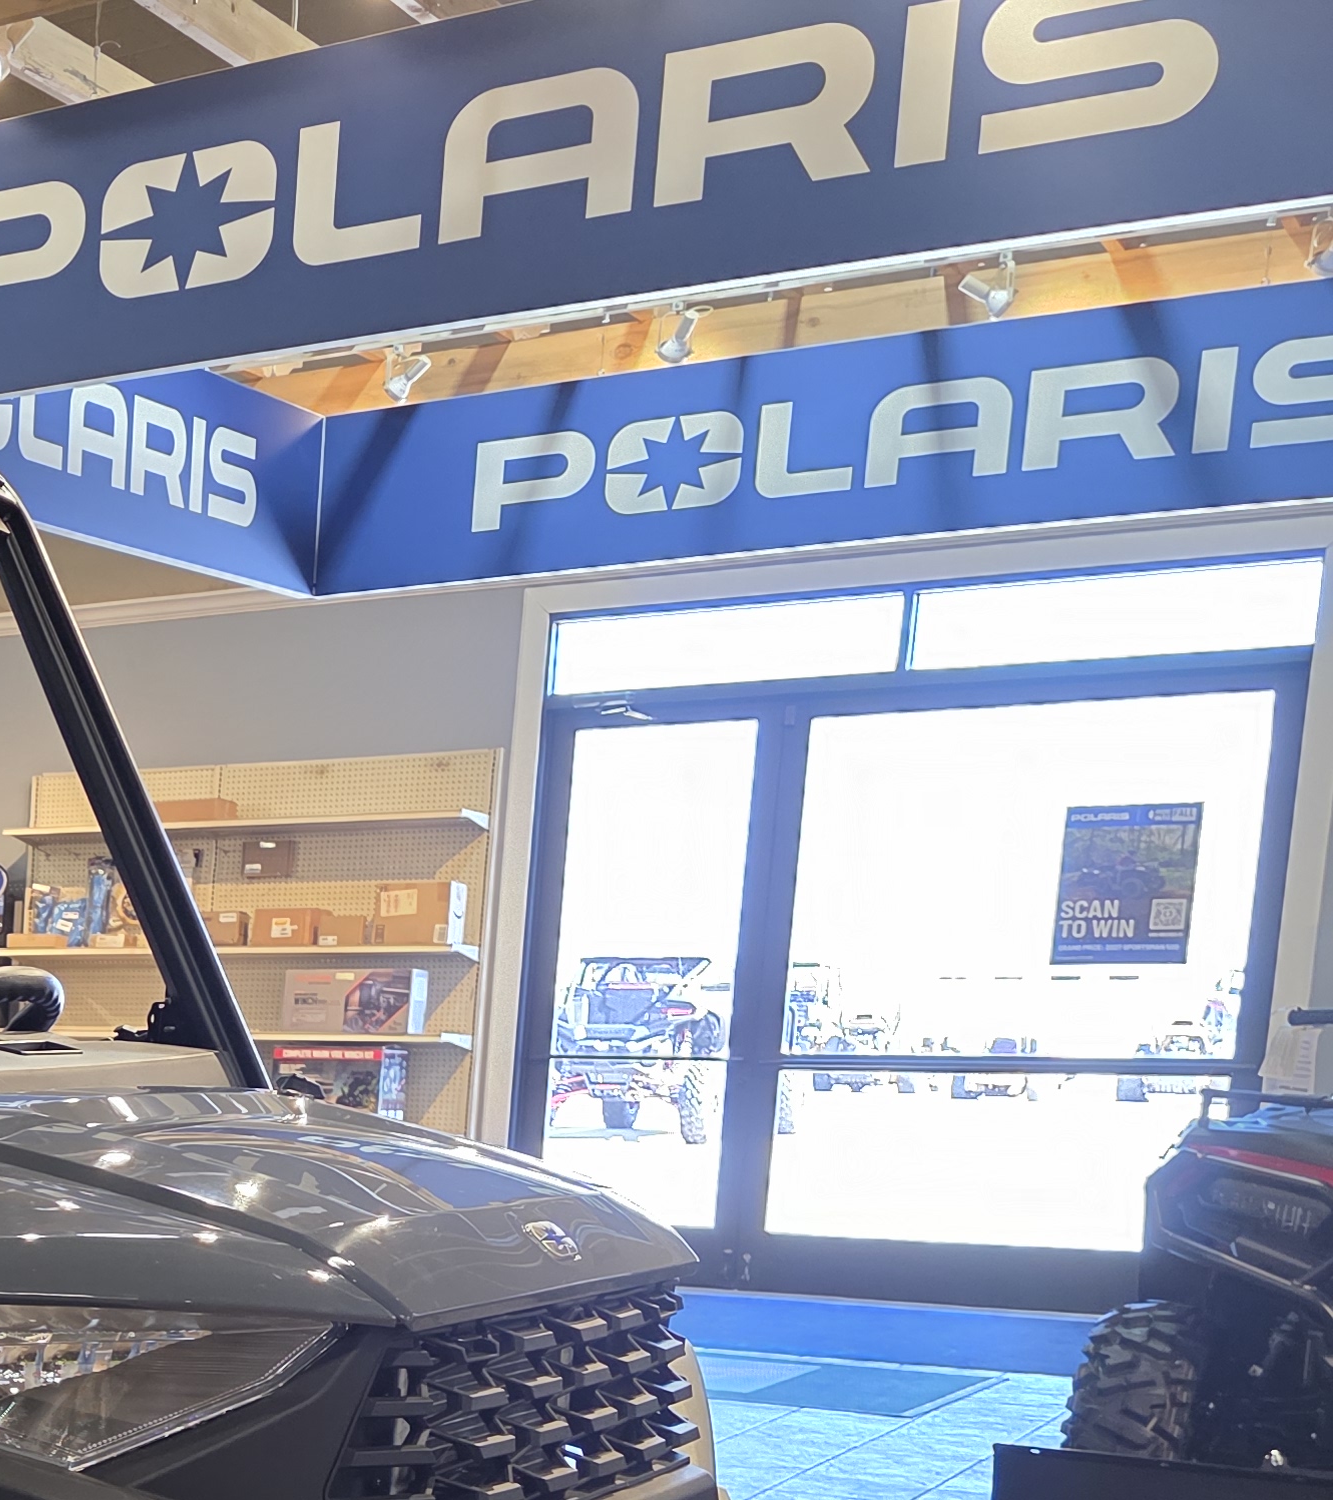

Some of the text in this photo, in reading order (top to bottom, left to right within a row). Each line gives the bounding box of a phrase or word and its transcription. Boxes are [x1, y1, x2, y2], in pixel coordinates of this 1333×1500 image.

[1071, 811, 1131, 822] POLARIS
[1060, 899, 1120, 919] SCAN
[1059, 919, 1136, 939] TO WIN
